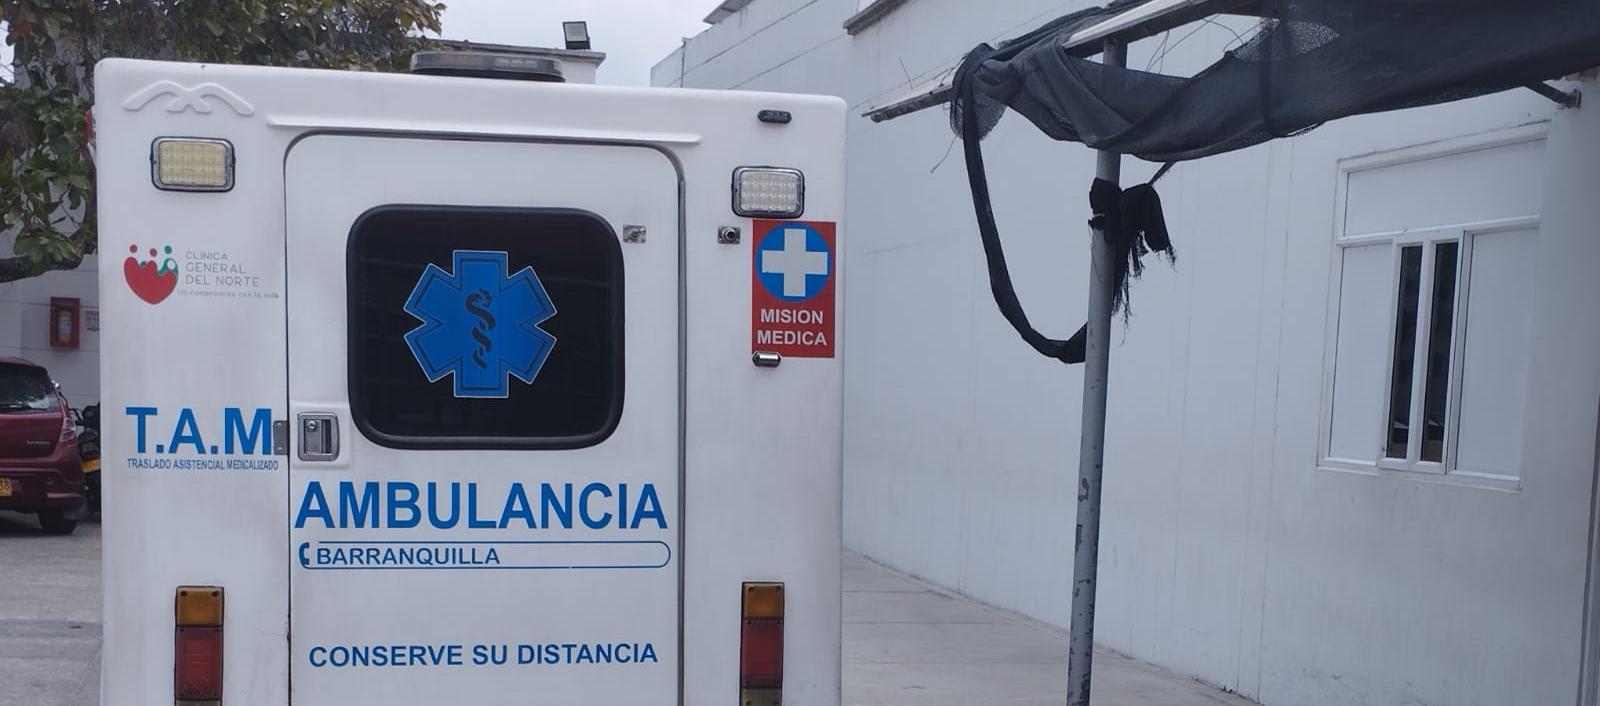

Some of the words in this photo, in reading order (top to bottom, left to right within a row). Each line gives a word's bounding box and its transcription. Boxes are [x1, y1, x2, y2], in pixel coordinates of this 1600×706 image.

[185, 261, 246, 275] GENERAL
[185, 274, 210, 286] DEL
[216, 275, 260, 287] NORTE
[760, 308, 824, 325] MISION
[757, 330, 828, 346] MEDICA
[126, 407, 272, 455] T.A.M
[127, 458, 171, 470] TRASLADO
[173, 458, 225, 470] ASISTENCIAL
[226, 459, 279, 470] MEDICALIZADO
[294, 481, 668, 529] AMBULANCIA
[316, 547, 501, 566] BARRANQUILLA
[308, 645, 463, 667] CONSERVE
[472, 644, 508, 666] SU
[517, 643, 658, 665] DISTANCIA
